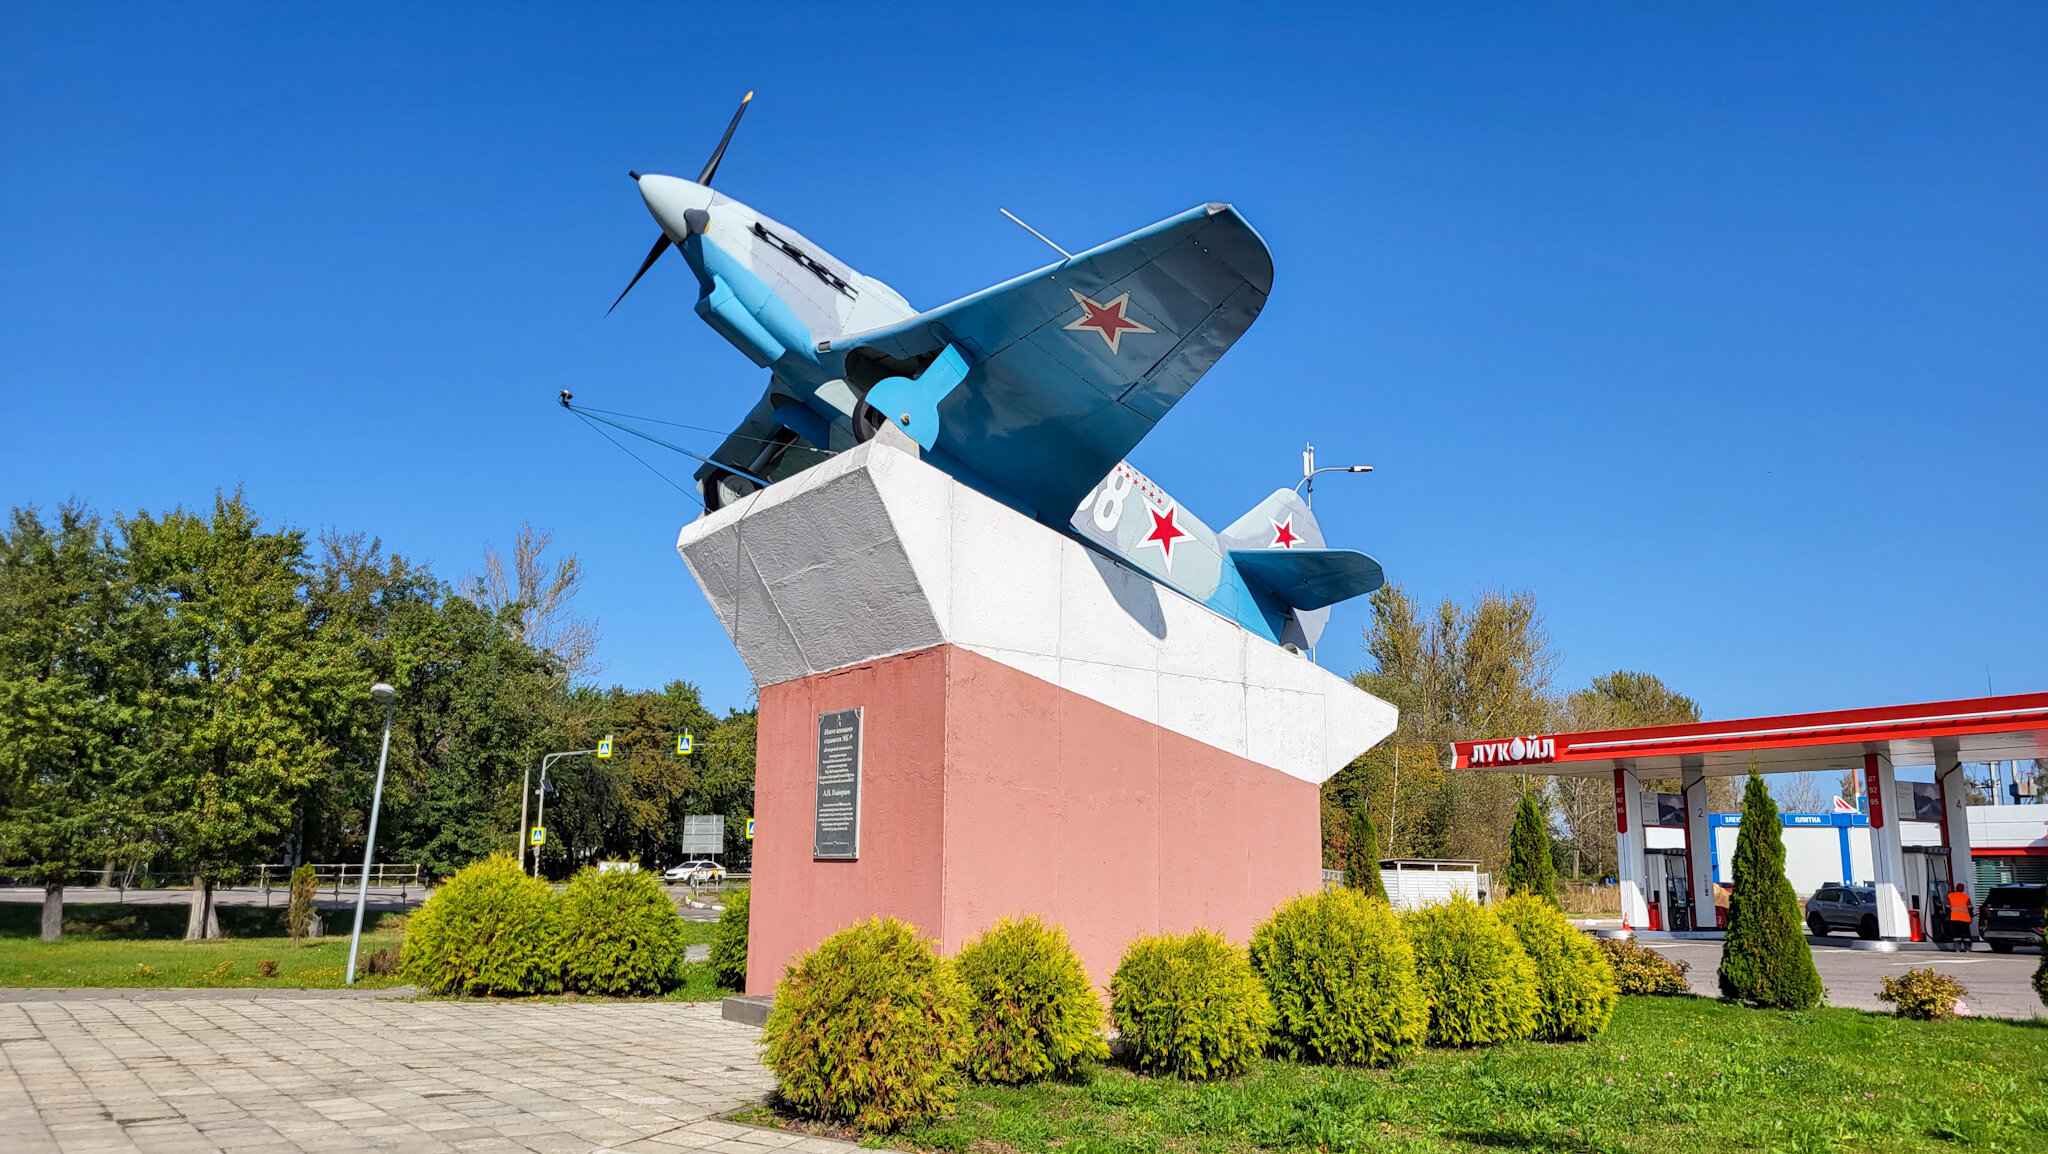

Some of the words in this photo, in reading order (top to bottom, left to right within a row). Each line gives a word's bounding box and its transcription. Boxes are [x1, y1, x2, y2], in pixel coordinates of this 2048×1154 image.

[1471, 734, 1555, 763] ЛУКОЙЛ
[1956, 799, 1962, 810] 4
[1698, 808, 1704, 818] 2
[1794, 816, 1822, 824] ПЛИТКА
